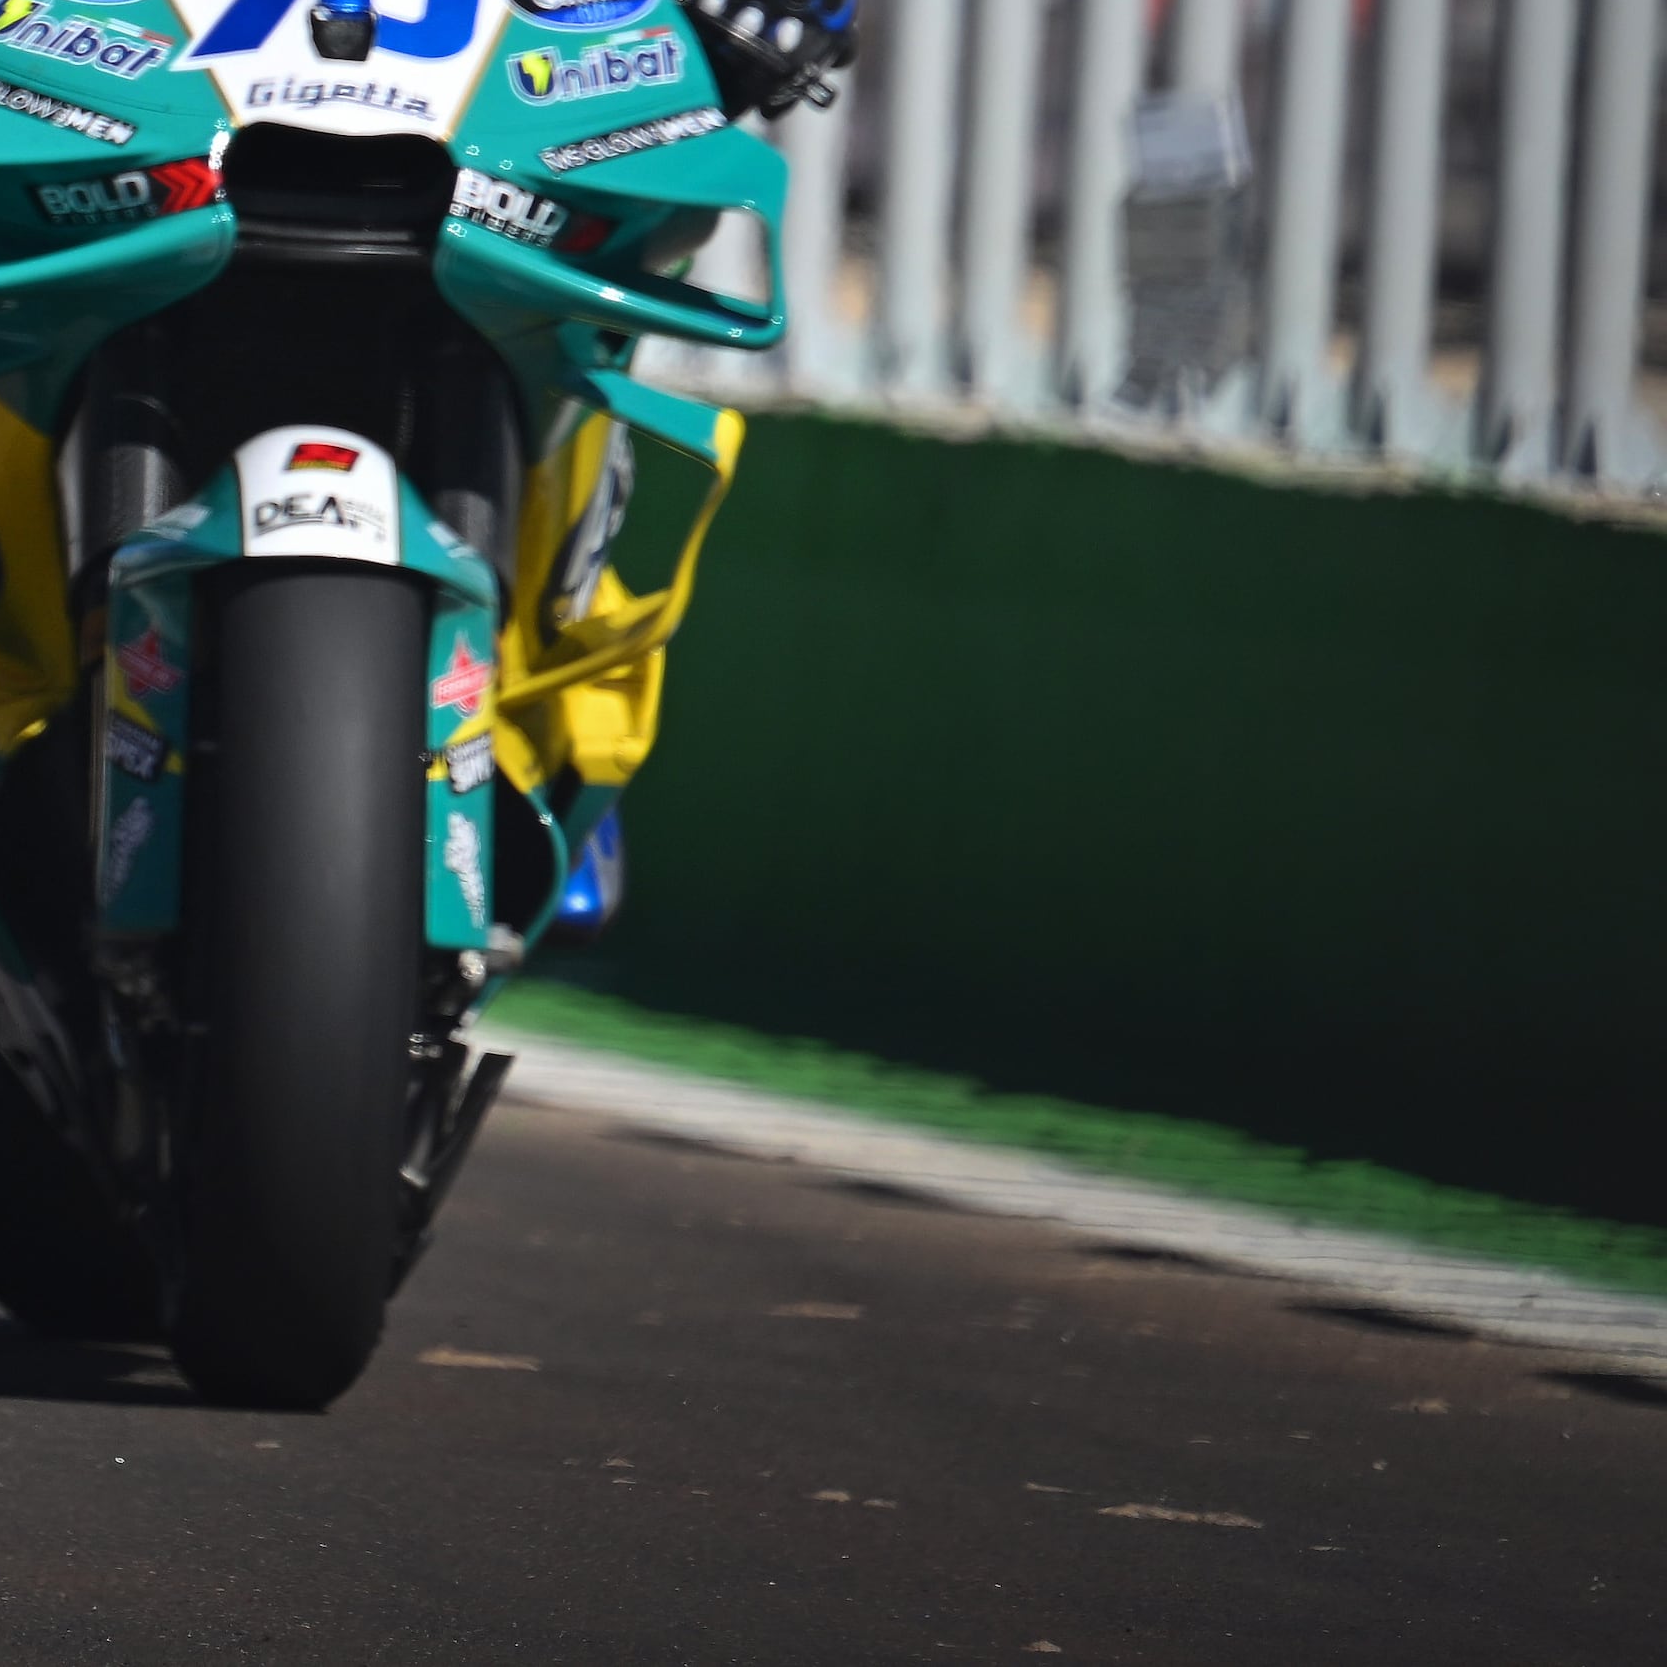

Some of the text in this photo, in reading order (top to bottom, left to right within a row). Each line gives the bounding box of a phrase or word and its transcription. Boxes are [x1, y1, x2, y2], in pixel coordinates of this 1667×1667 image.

[520, 40, 679, 97] Unibat
[247, 78, 437, 122] Gigetta
[37, 170, 153, 216] BOLD
[453, 167, 568, 235] BOLD
